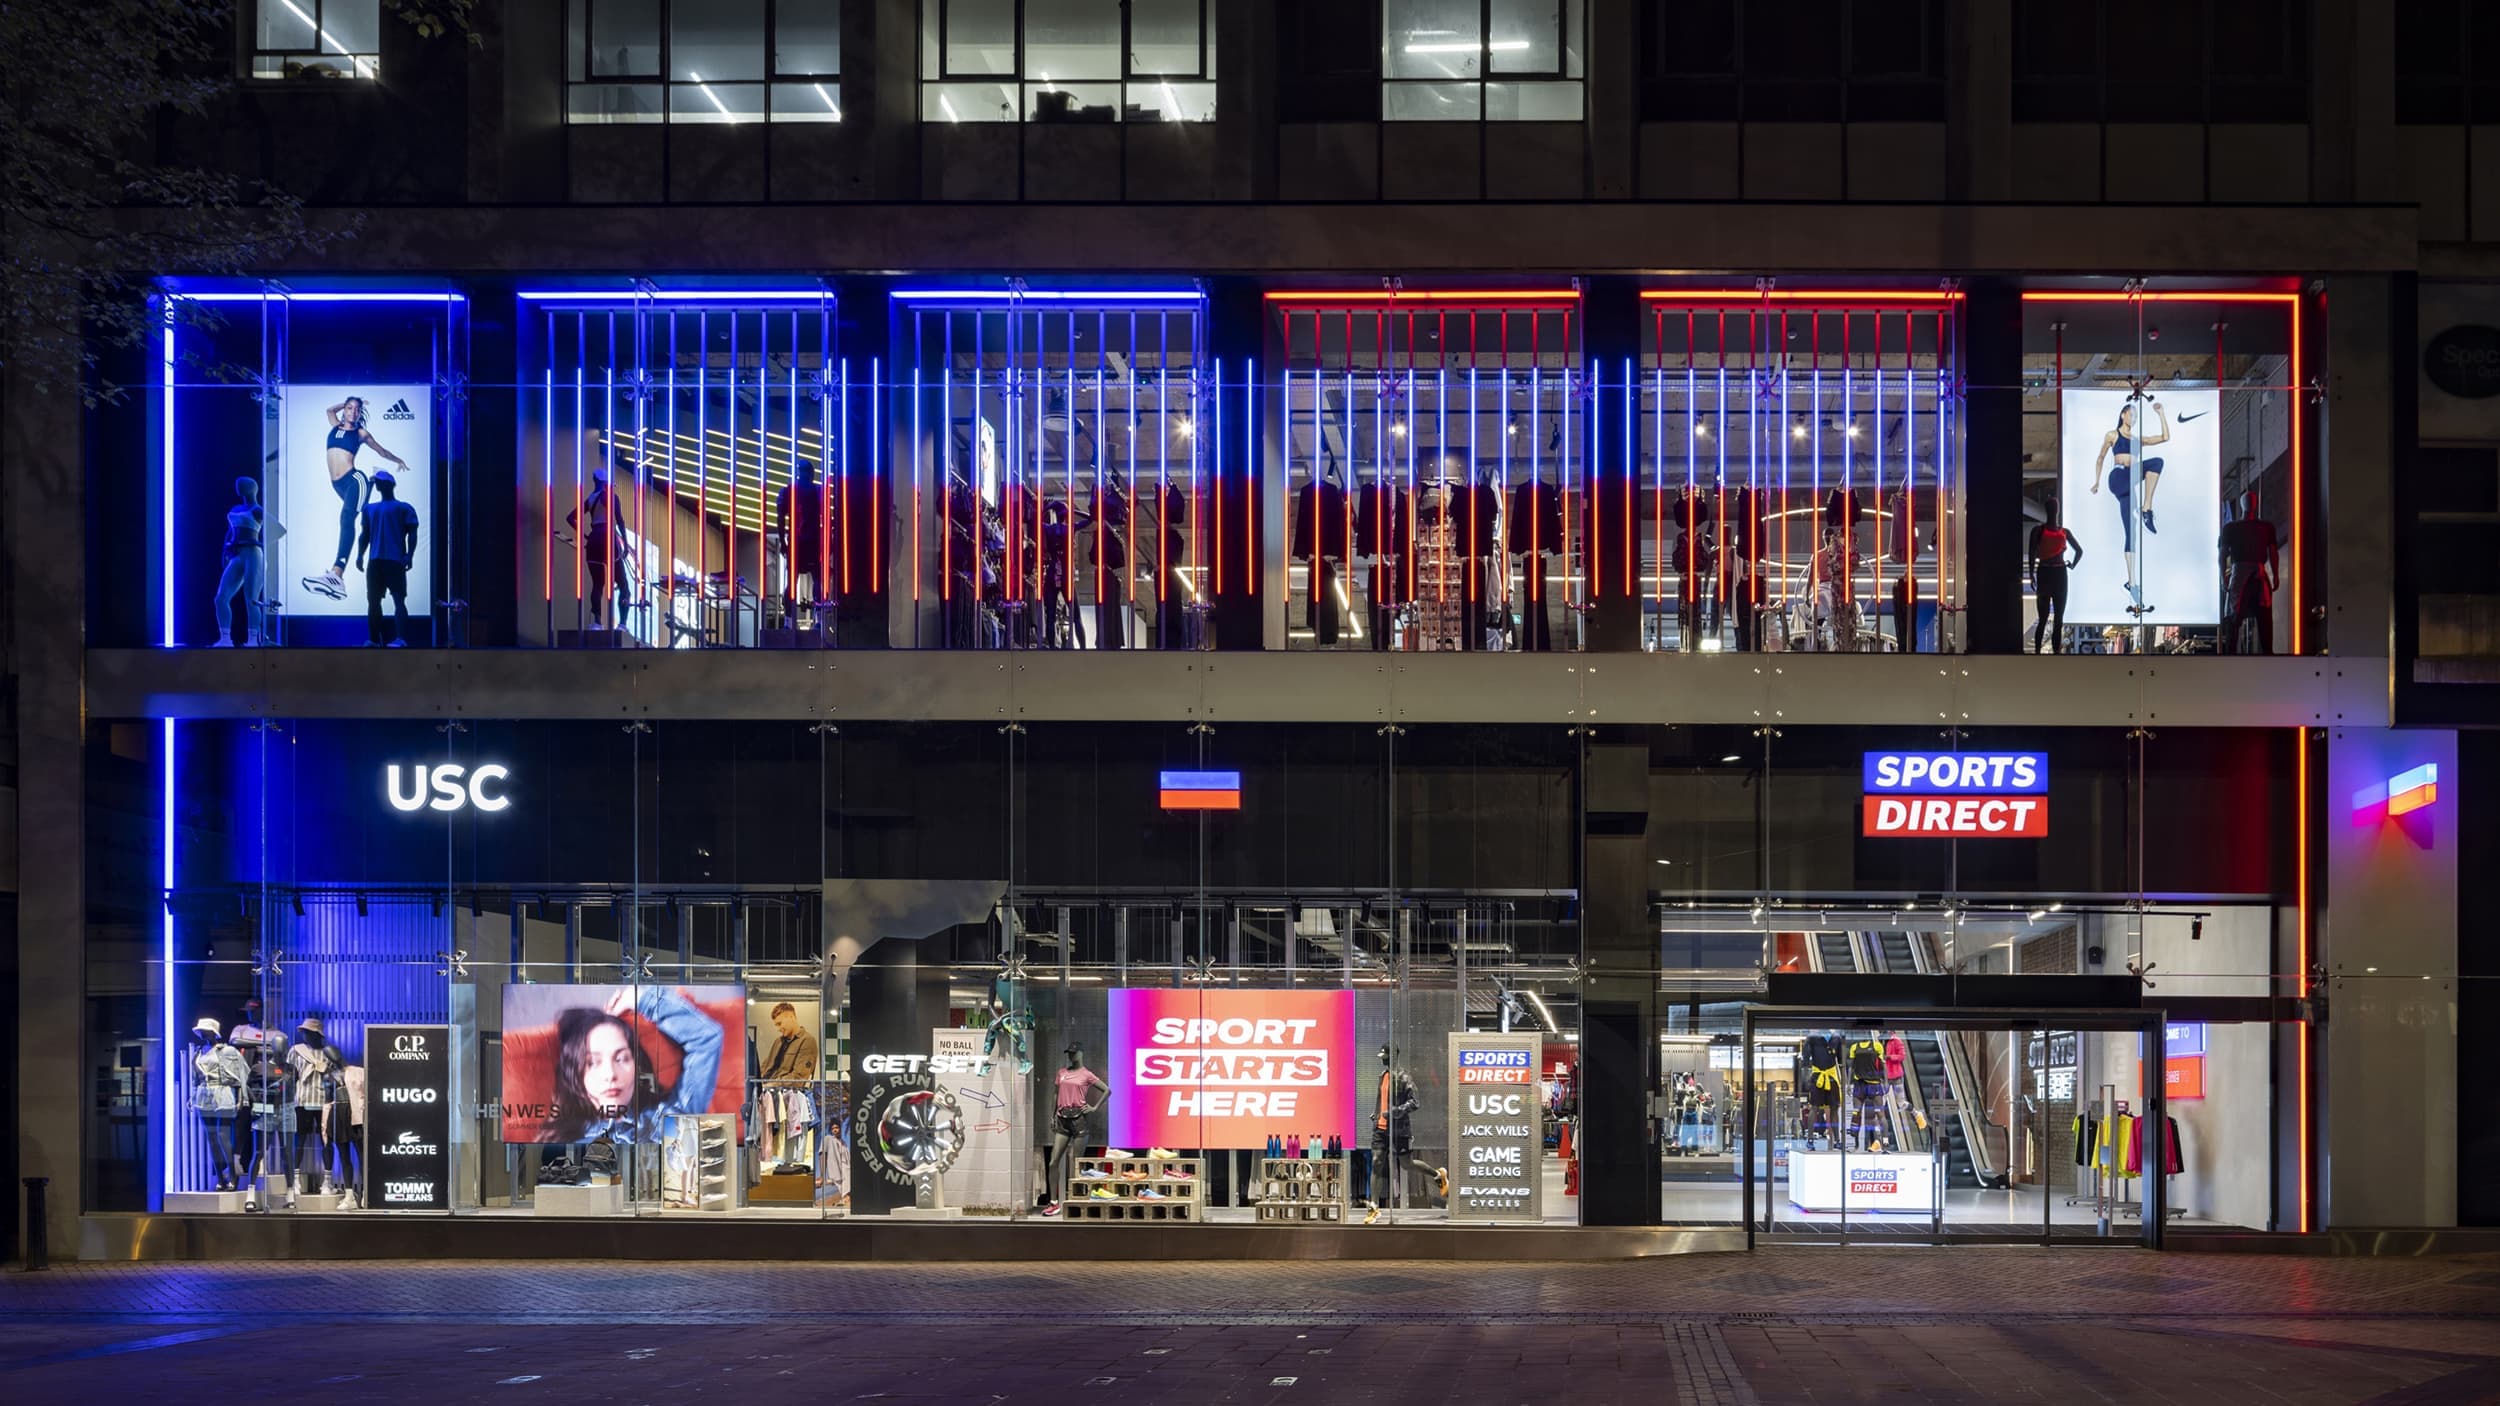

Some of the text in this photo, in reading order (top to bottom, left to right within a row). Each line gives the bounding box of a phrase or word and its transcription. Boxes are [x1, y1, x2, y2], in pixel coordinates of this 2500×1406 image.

[383, 411, 415, 420] adidas
[1875, 756, 2037, 788] SPORTS
[387, 764, 510, 812] USC
[1876, 800, 2037, 832] DIRECT
[1151, 1017, 1317, 1045] SPORT
[394, 1035, 426, 1052] C.P.
[939, 1040, 973, 1050] NO BALL
[389, 1052, 430, 1061] COMPANY
[1464, 1052, 1527, 1065] SPORTS
[2028, 1035, 2076, 1068] STRTS
[862, 1054, 990, 1074] GET SET
[1141, 1054, 1323, 1081] STARTS
[889, 1073, 931, 1088] RUN
[1464, 1069, 1526, 1082] DIRECT
[382, 1088, 437, 1103] HUGO
[517, 1103, 545, 1119] WE
[550, 1104, 628, 1120] SMER
[1167, 1091, 1299, 1118] HERE
[1469, 1094, 1521, 1116] USC
[855, 1084, 885, 1173] REASONS
[1462, 1125, 1529, 1137] JACK WILLS
[381, 1144, 437, 1155] LACOSTE
[1469, 1146, 1521, 1163] GAME
[1469, 1166, 1521, 1177] BELONG
[1853, 1171, 1895, 1180] SPORTS
[384, 1182, 434, 1194] TOMMY
[1460, 1187, 1530, 1196] EVANS
[1854, 1184, 1894, 1192] DIRECT
[404, 1193, 434, 1202] JEANS
[1470, 1199, 1521, 1208] CYCLES
